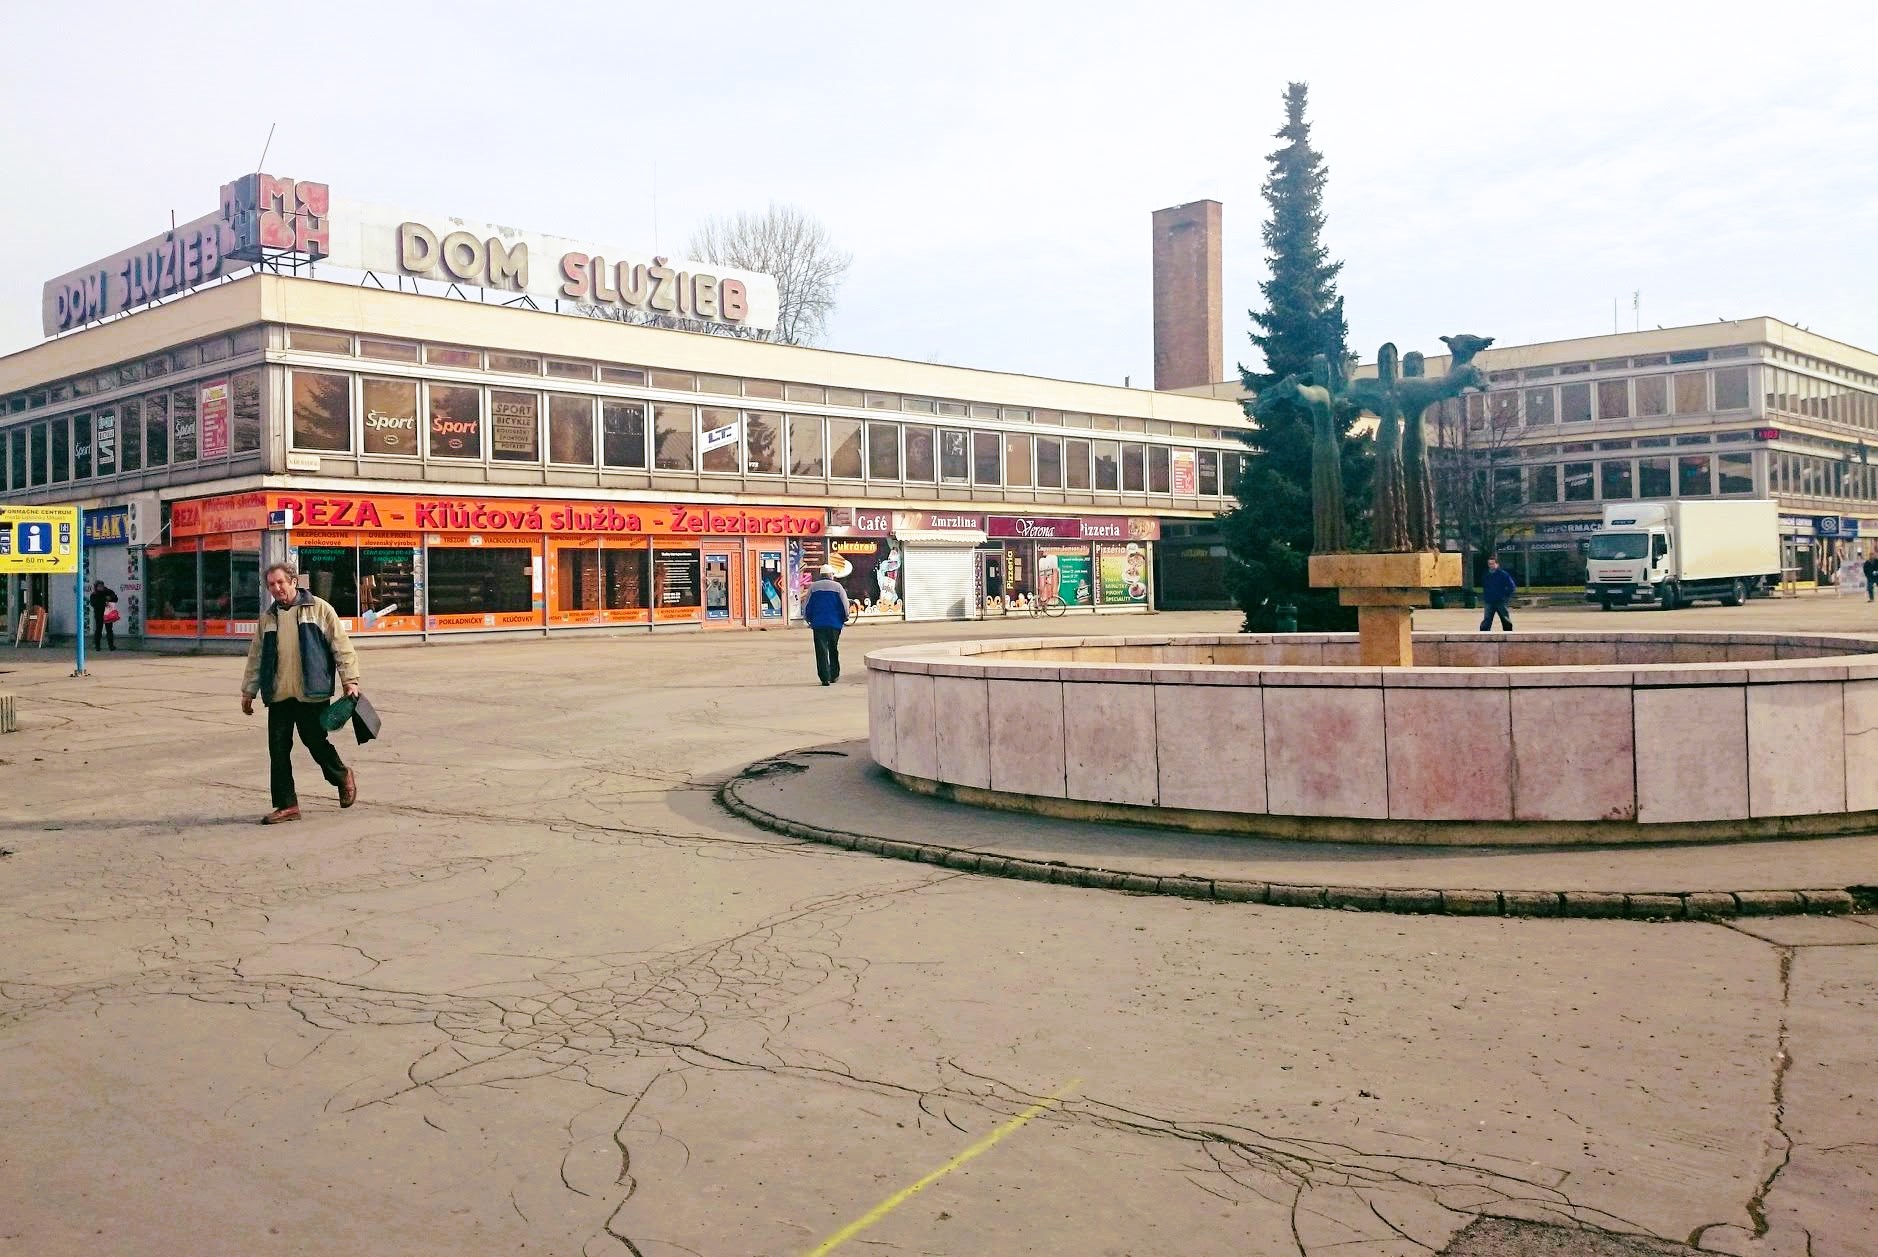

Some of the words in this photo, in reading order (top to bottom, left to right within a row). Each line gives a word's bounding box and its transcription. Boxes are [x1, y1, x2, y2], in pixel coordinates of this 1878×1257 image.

[398, 221, 529, 289] DOM
[562, 252, 748, 321] SLUŽIEB
[56, 271, 106, 325] DOM
[496, 404, 532, 415] SPORT
[366, 410, 415, 430] Šport
[433, 415, 478, 434] Šport
[496, 415, 531, 426] BICYKLE
[277, 498, 381, 528] BEZA
[415, 501, 543, 530] Kľúčová
[550, 506, 642, 532] služba
[669, 506, 822, 534] Železiarstvo
[858, 515, 888, 531] Café
[931, 515, 977, 528] Zmrzlina
[1016, 519, 1055, 537] Verona
[1006, 550, 1014, 589] Pizzeria
[439, 616, 483, 626] POKLADNIČKY
